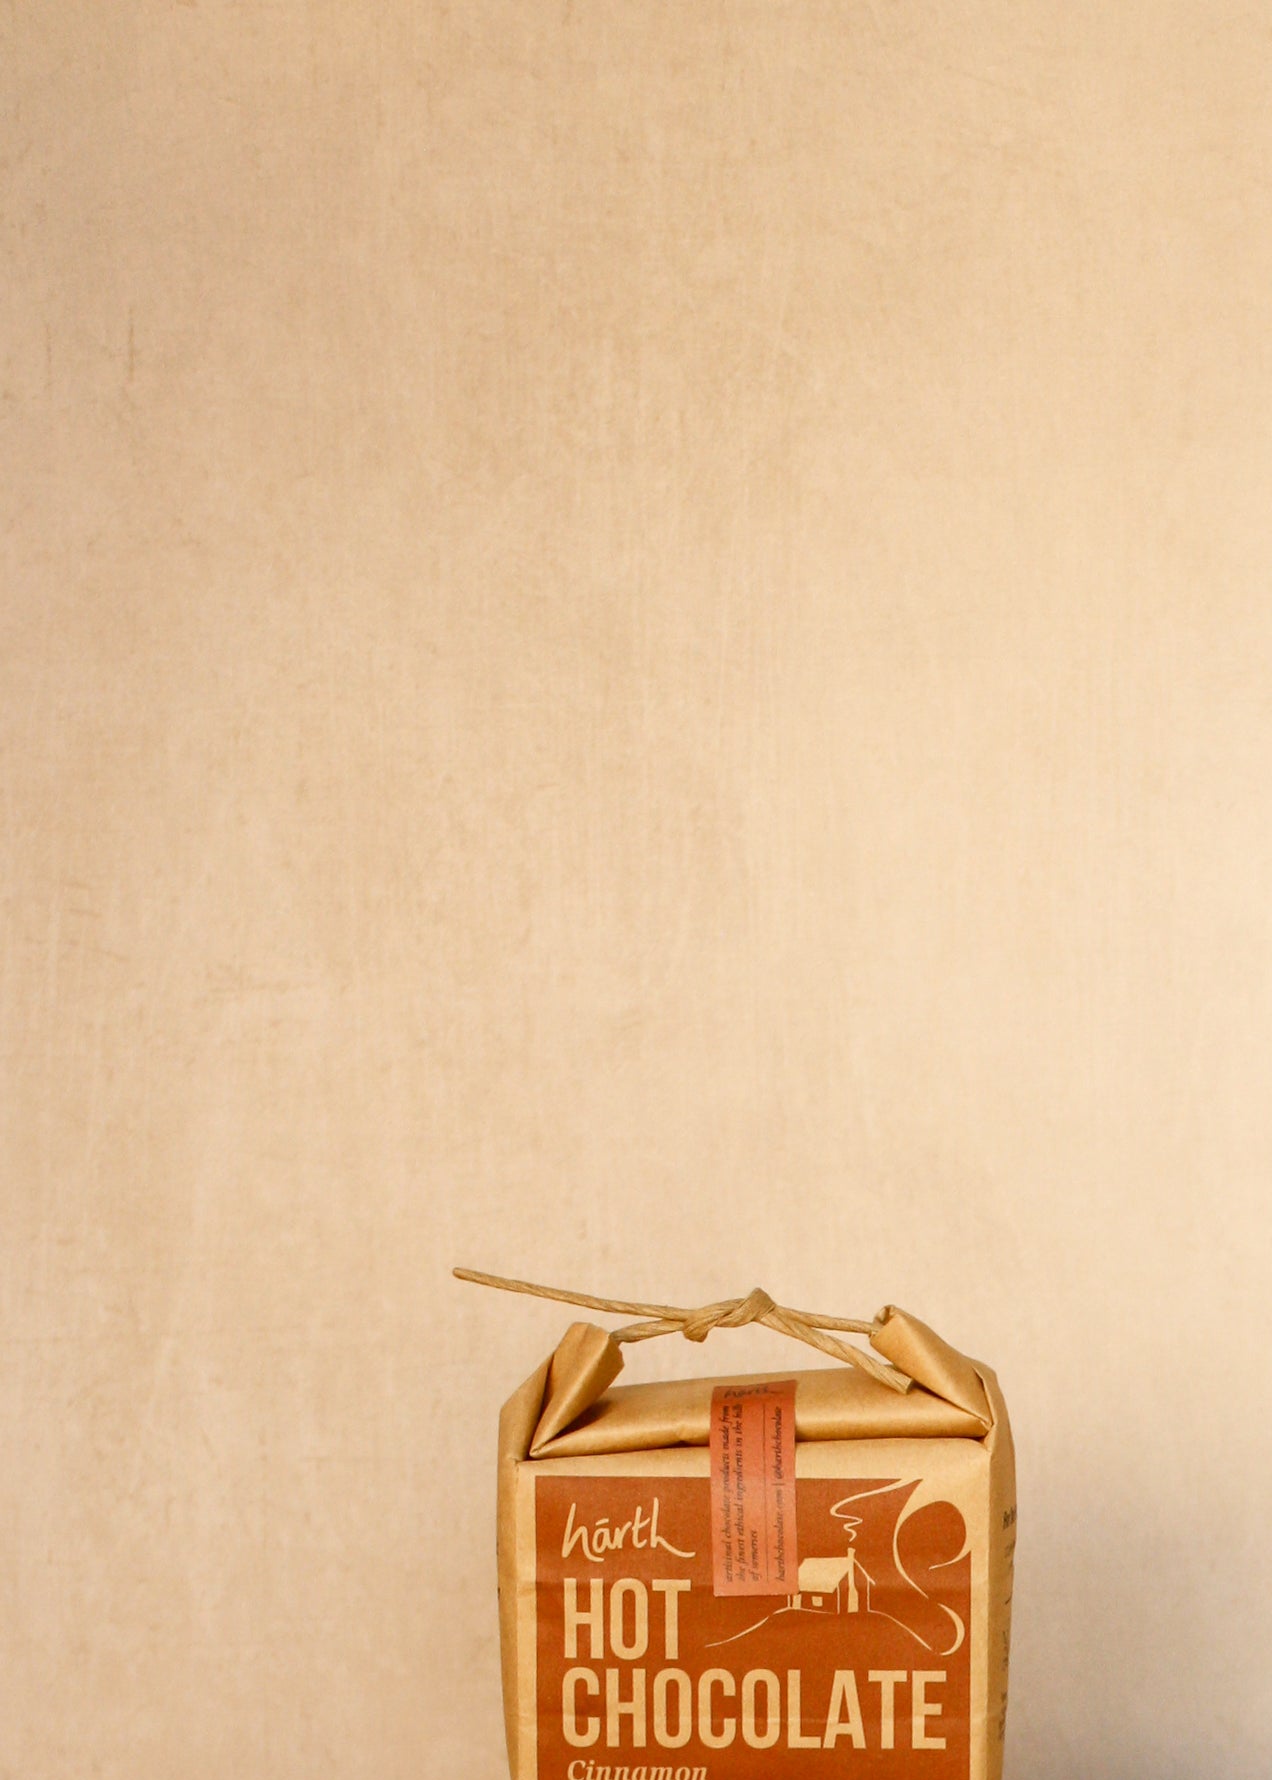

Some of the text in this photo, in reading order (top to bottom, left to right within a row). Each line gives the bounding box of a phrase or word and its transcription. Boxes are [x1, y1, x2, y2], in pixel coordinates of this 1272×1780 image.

[719, 1406, 732, 1424] from
[733, 1421, 742, 1434] the
[719, 1426, 729, 1449] made
[736, 1438, 742, 1447] in
[719, 1453, 733, 1494] products
[734, 1450, 746, 1500] ingredients
[721, 1495, 732, 1538] chocolate
[734, 1504, 744, 1536] ethical
[735, 1539, 748, 1566] finest
[735, 1568, 745, 1581] the
[748, 1570, 761, 1582] of
[563, 1577, 692, 1660] HOT
[561, 1667, 948, 1750] CHOCOLATE
